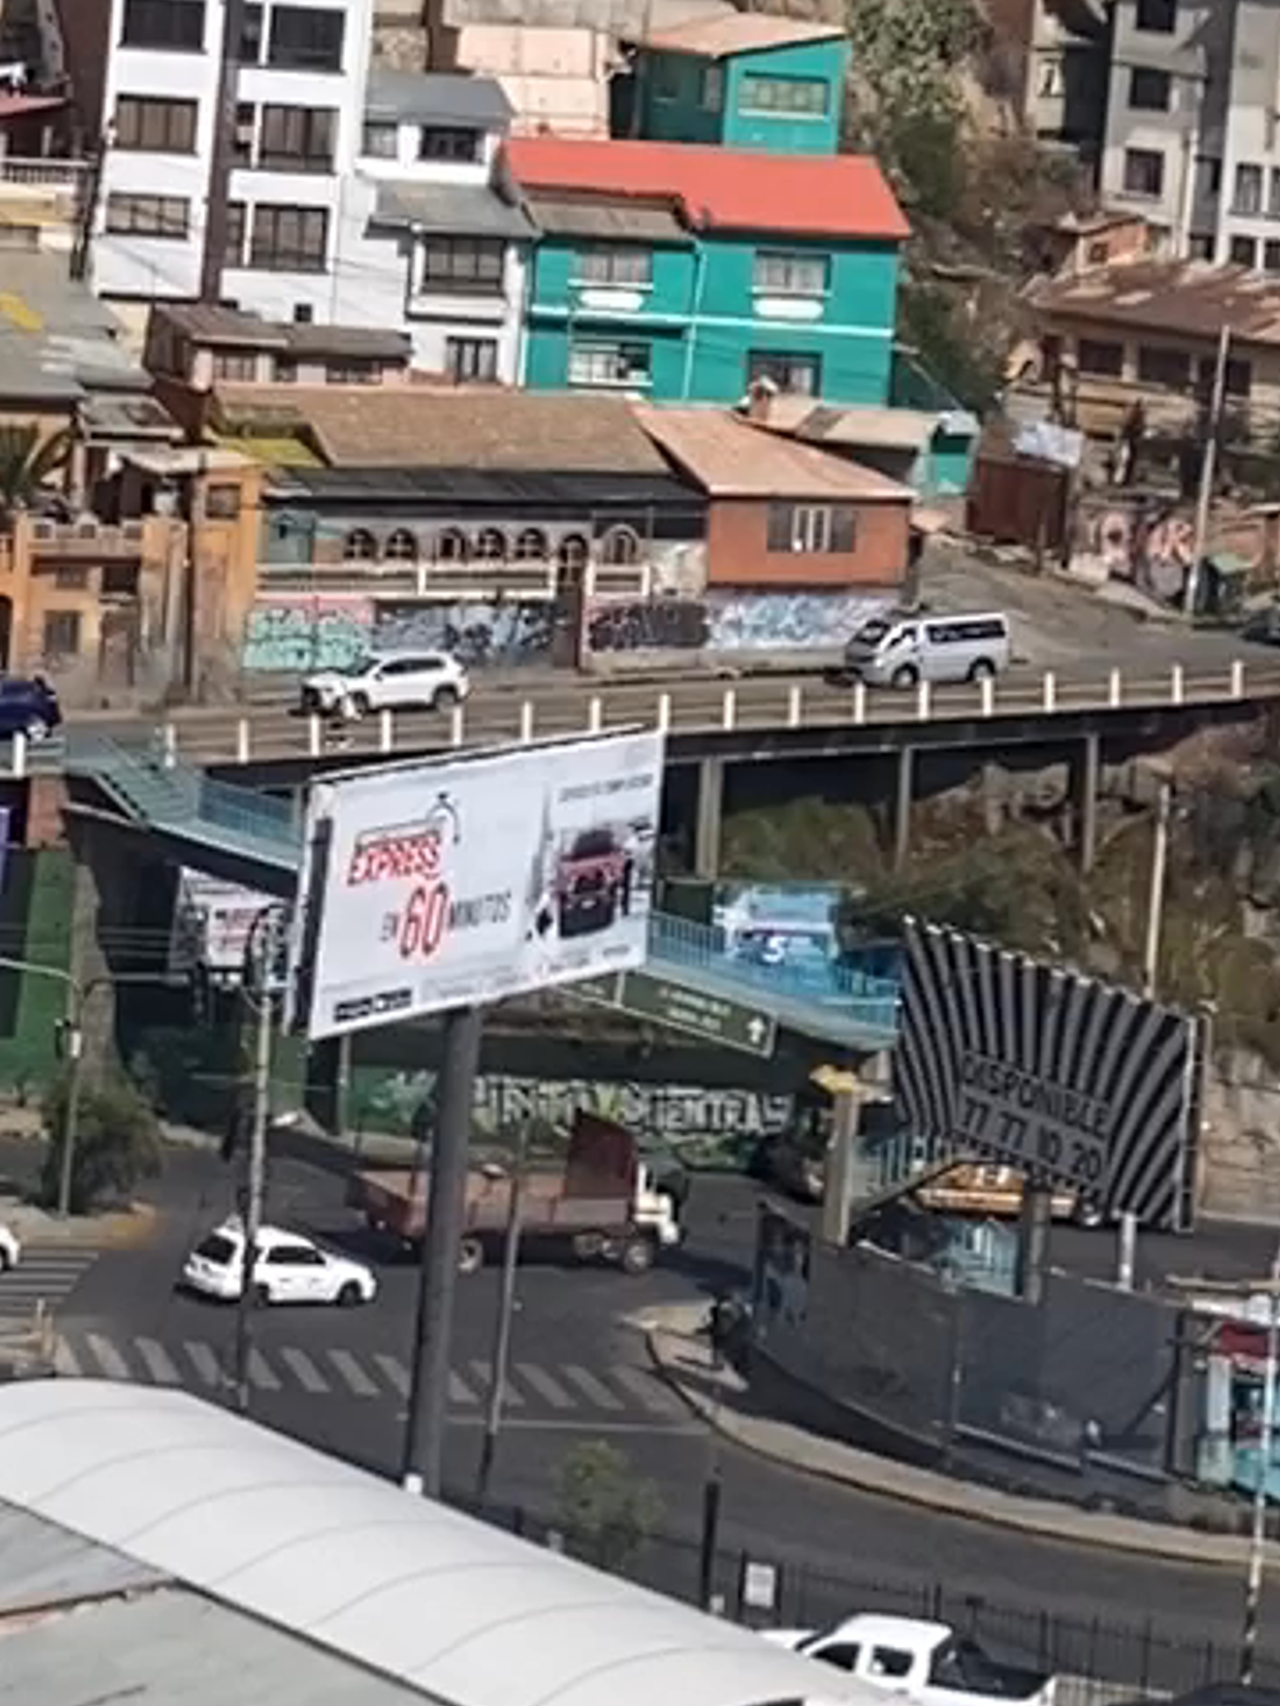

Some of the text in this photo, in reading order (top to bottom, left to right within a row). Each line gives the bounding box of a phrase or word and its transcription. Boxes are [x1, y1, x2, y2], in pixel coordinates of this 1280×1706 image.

[347, 829, 441, 887] EXPRESS
[400, 882, 448, 959] 60
[449, 889, 512, 931] MINUTOS
[962, 1052, 1109, 1141] DISPONIBLE
[962, 1096, 991, 1135] 77
[998, 1110, 1027, 1150] 77
[1072, 1141, 1102, 1182] 20
